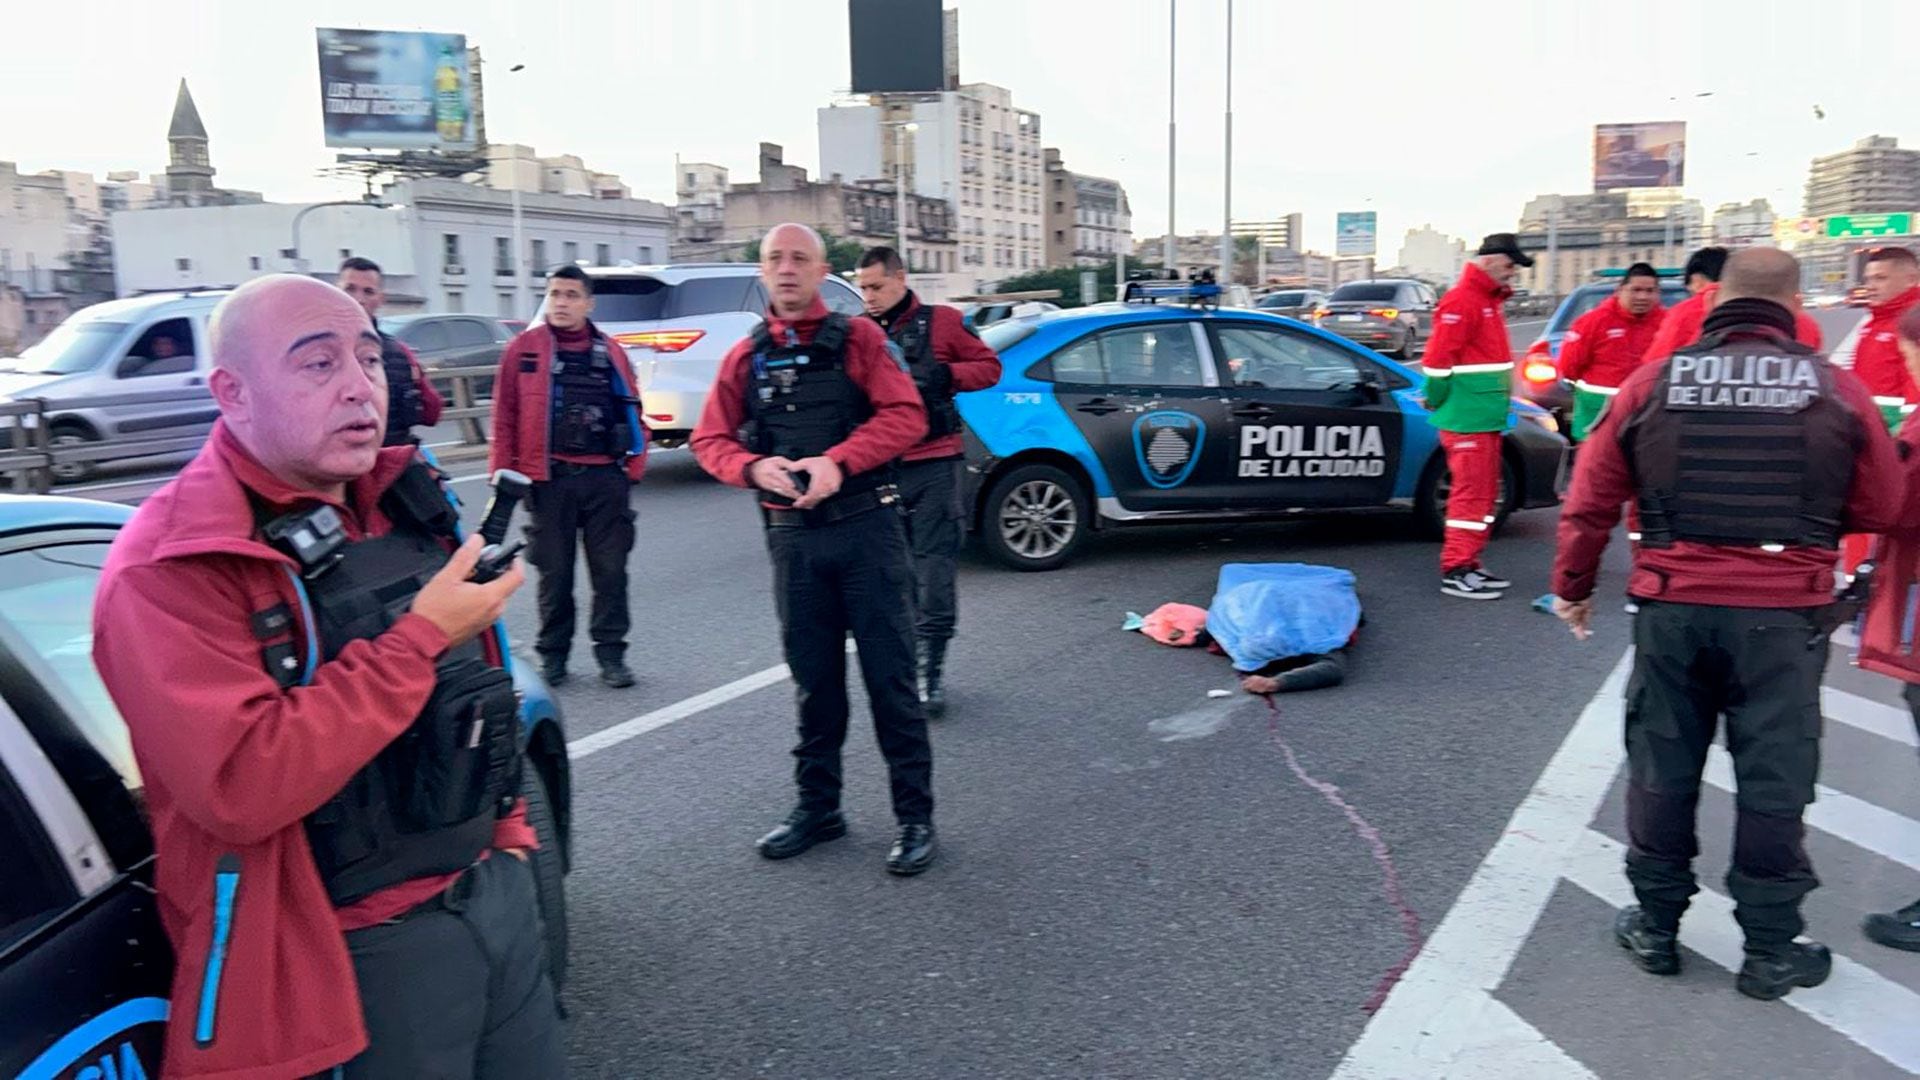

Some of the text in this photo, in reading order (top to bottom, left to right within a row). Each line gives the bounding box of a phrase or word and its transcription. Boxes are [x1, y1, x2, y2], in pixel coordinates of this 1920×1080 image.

[1670, 355, 1819, 387] POLICIA
[1667, 386, 1698, 405] DE
[1701, 387, 1733, 406] LA
[1240, 425, 1385, 457] POLICIA
[1238, 459, 1385, 477] DE LA CIUDAD
